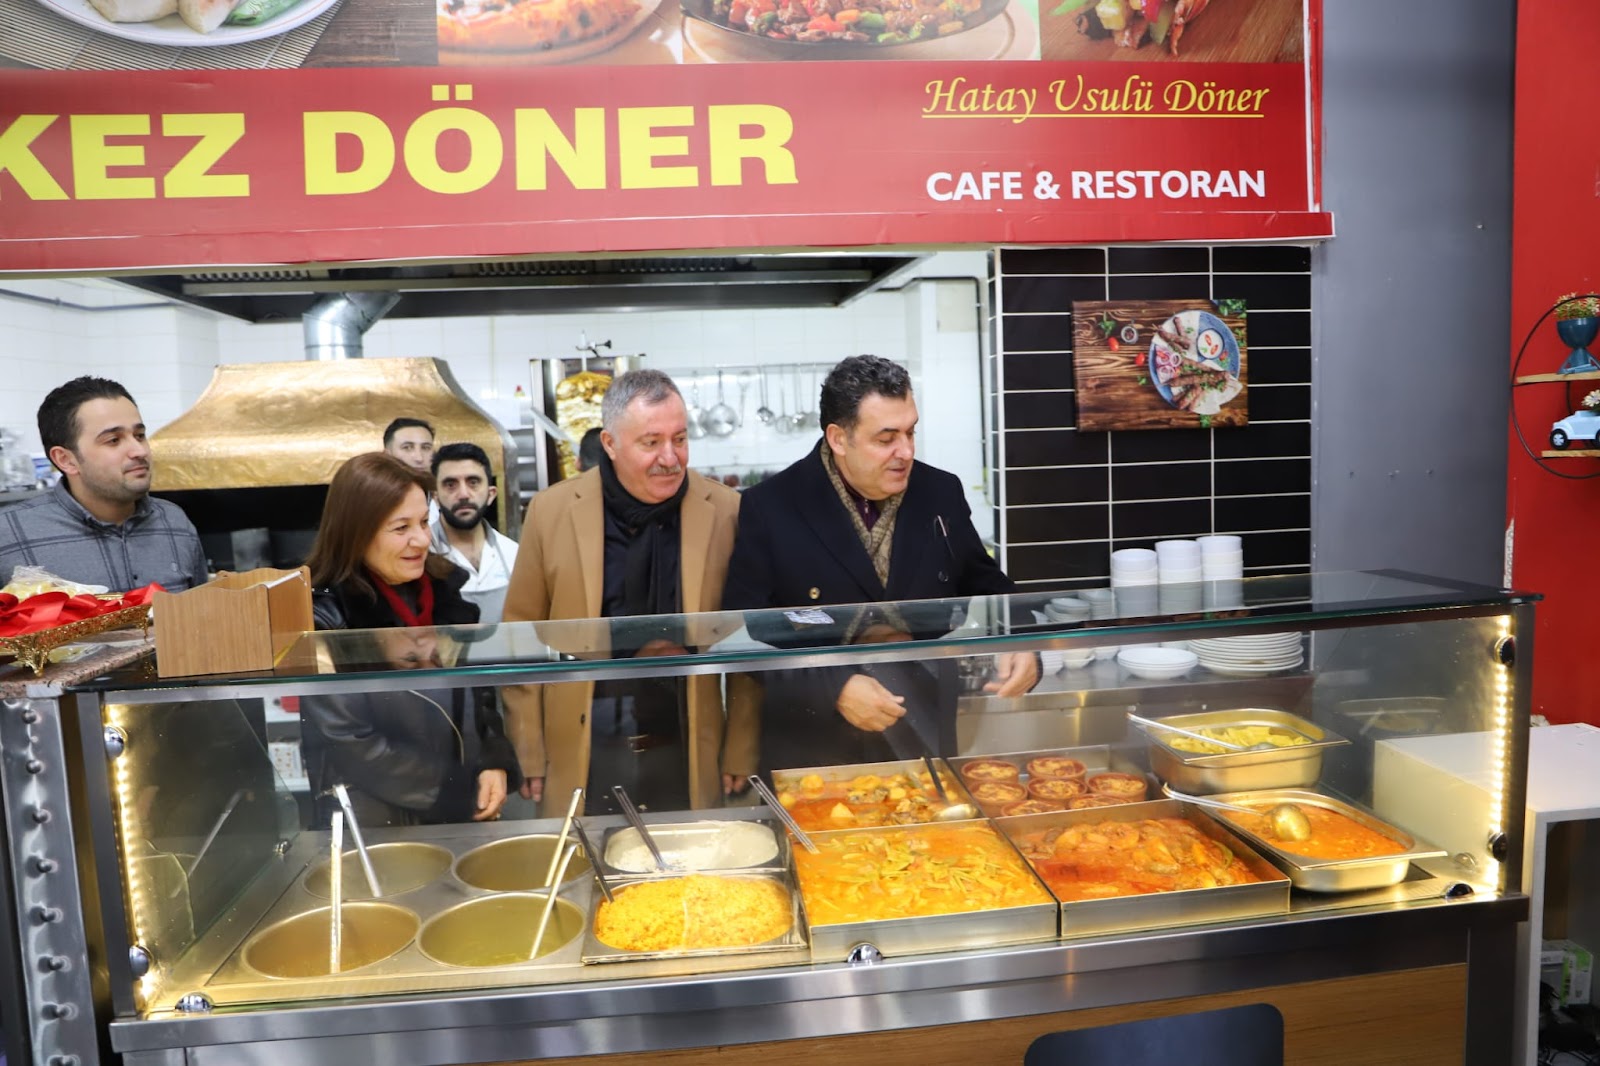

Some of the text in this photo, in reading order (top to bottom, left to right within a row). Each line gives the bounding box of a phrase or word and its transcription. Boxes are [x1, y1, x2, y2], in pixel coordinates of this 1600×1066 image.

[922, 75, 1270, 123] Hatay Usulü Döner
[302, 84, 798, 196] DÖNER
[926, 170, 1265, 201] CAFE & RESTORAN
